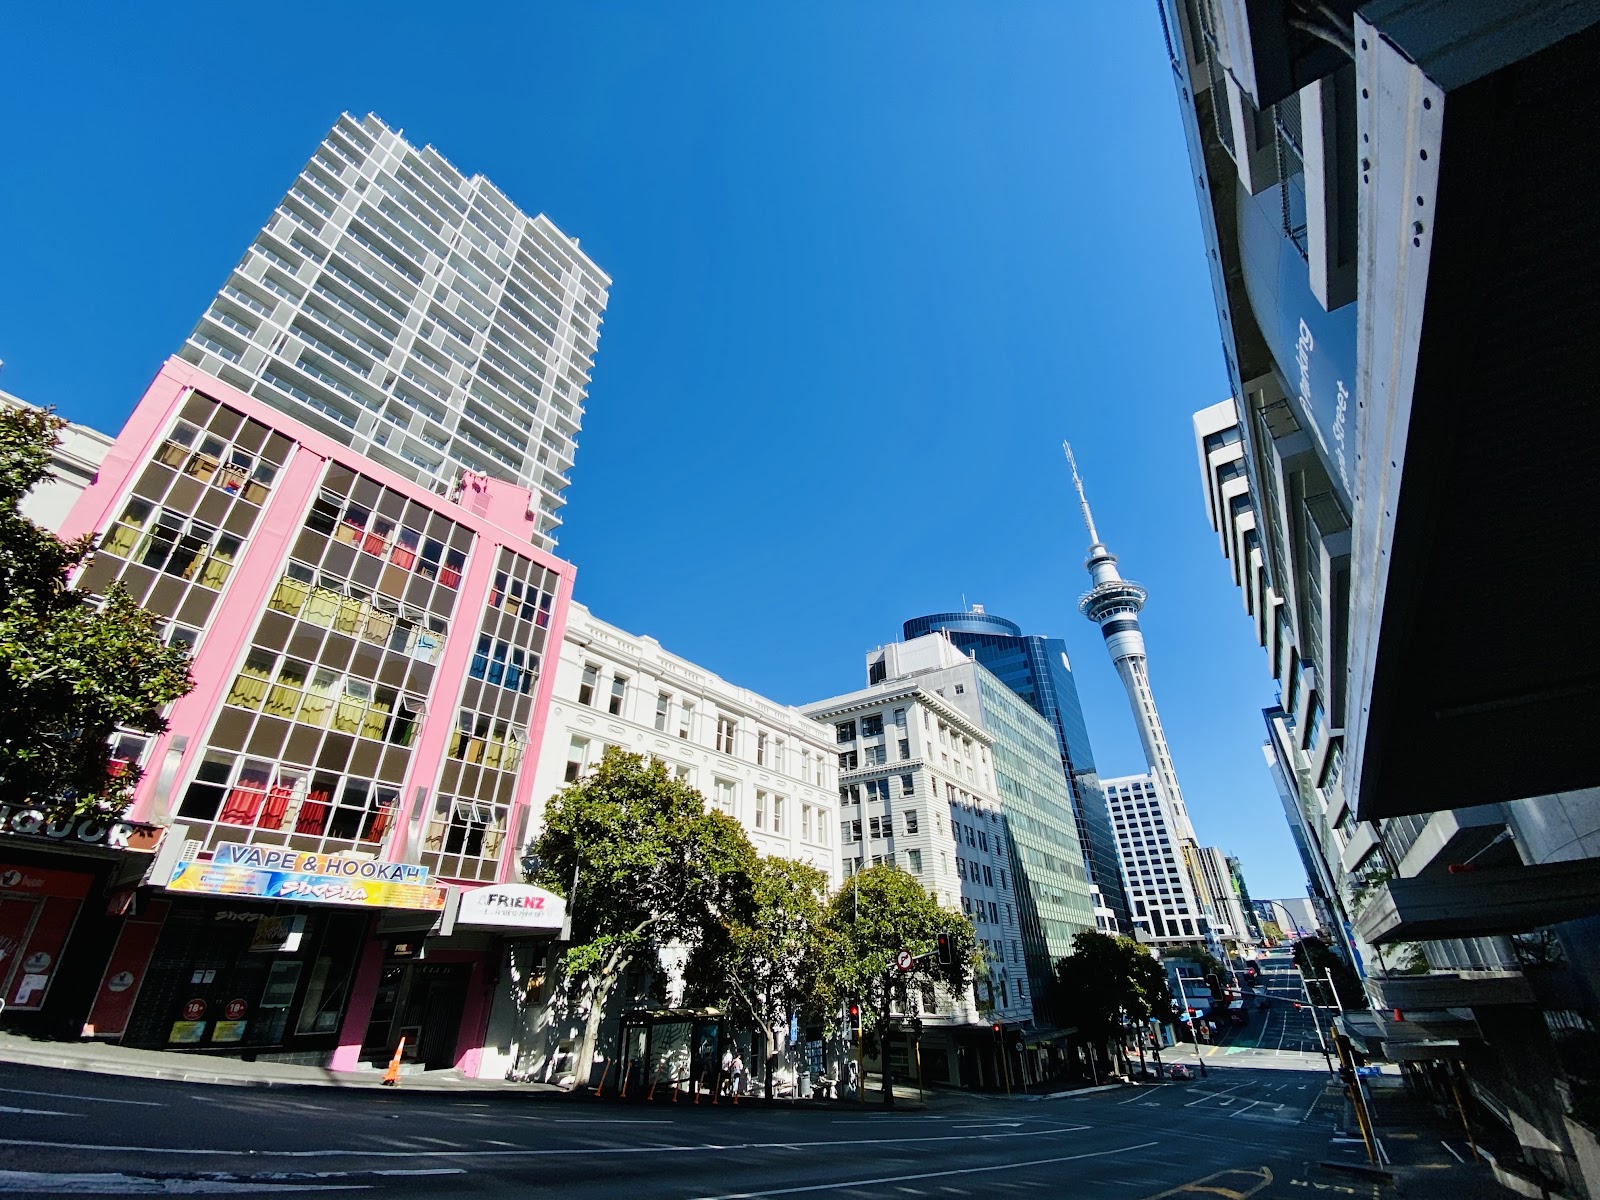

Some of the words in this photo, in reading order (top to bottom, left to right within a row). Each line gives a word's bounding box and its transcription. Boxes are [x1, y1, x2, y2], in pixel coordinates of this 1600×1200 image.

[230, 845, 296, 870] VAPE
[302, 855, 318, 872] &
[325, 858, 421, 881] HOOKAH
[487, 893, 546, 910] FRIENZ
